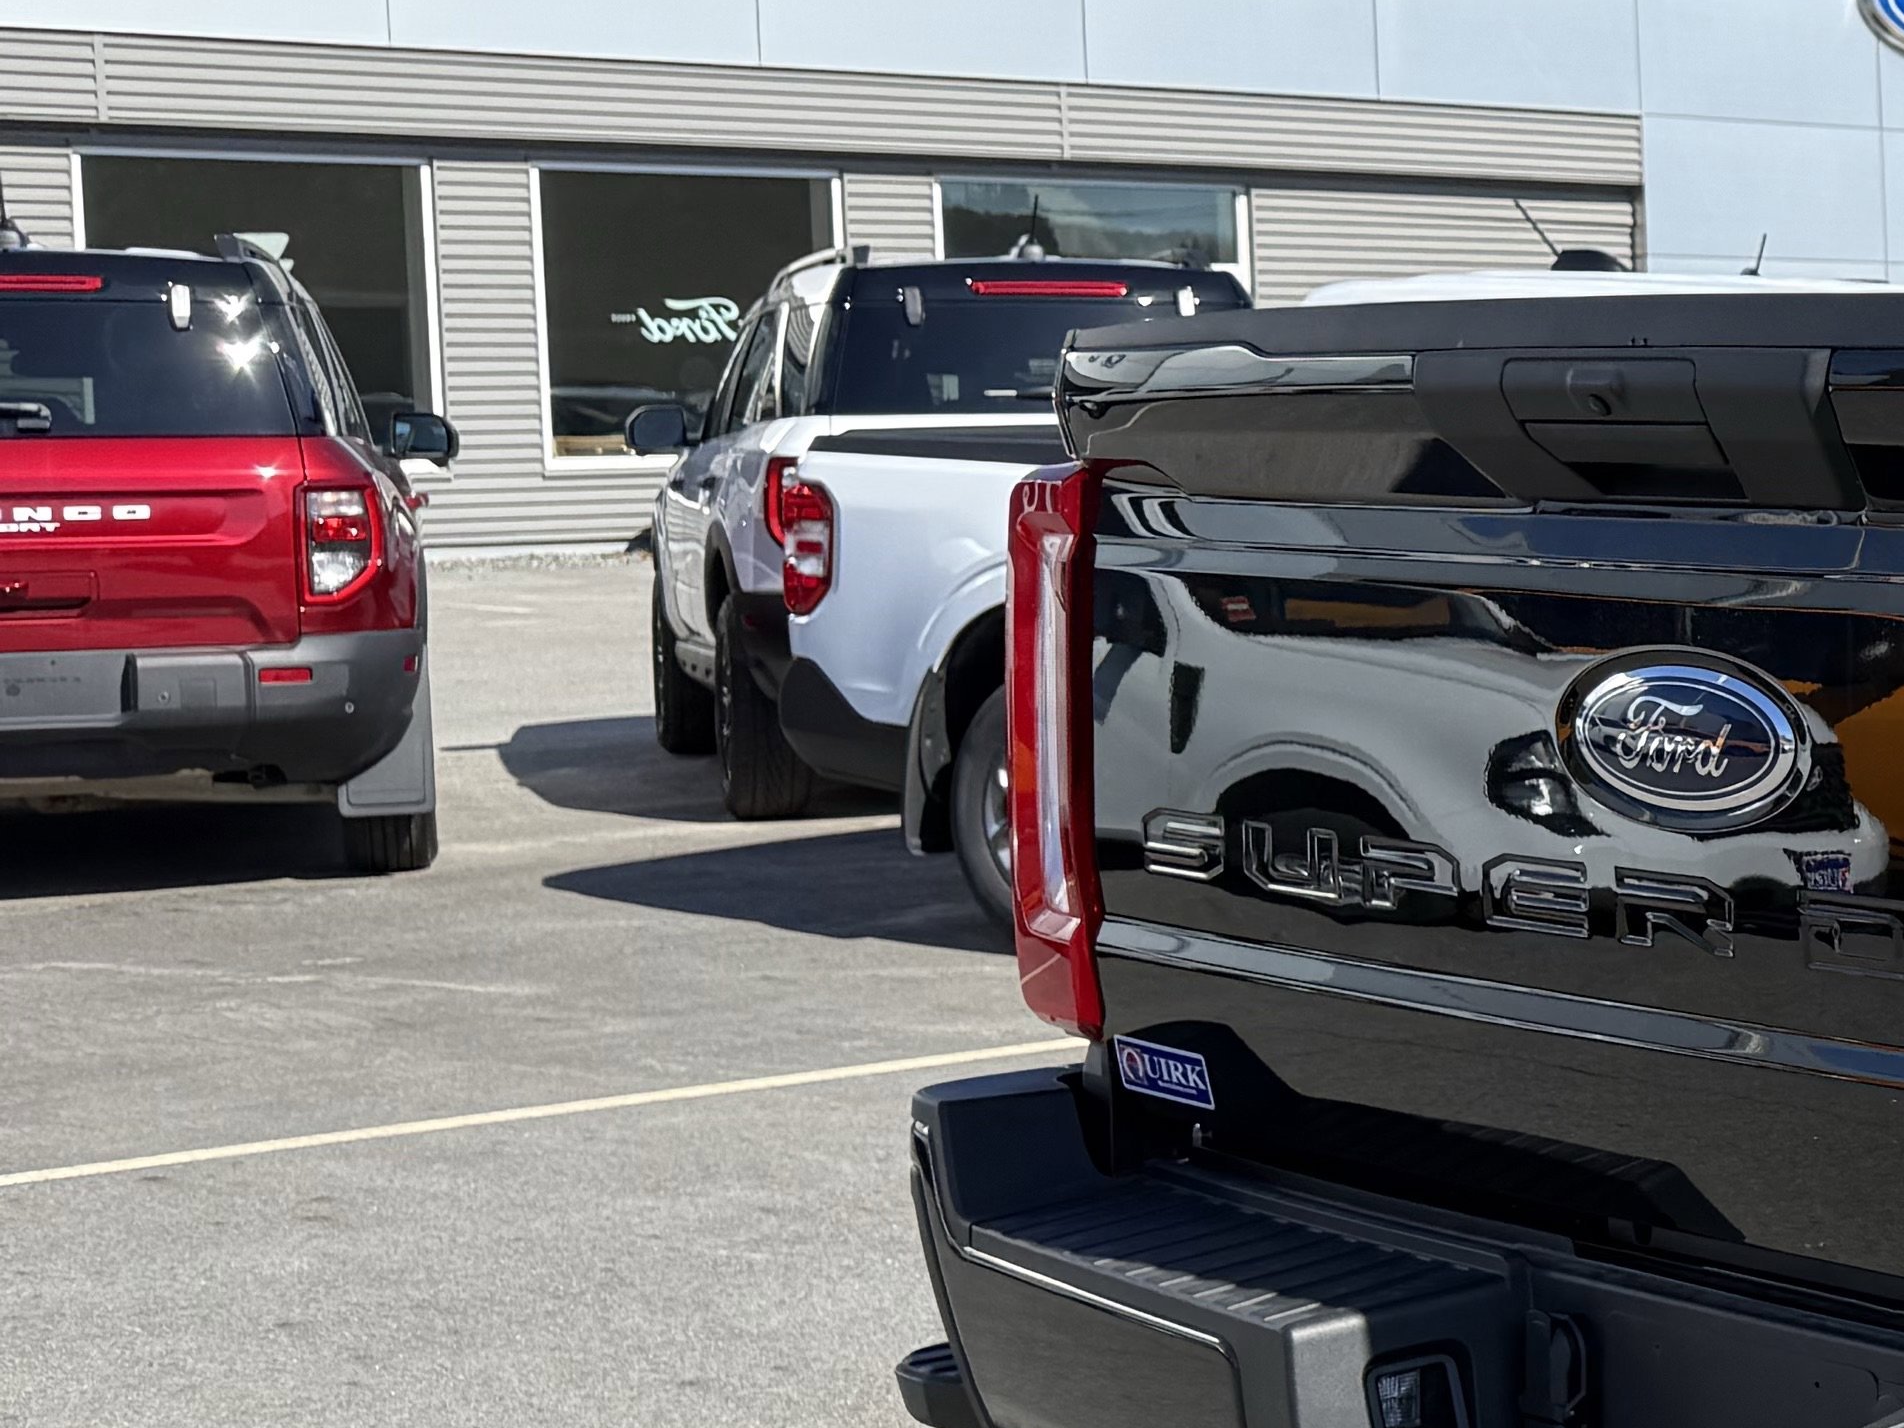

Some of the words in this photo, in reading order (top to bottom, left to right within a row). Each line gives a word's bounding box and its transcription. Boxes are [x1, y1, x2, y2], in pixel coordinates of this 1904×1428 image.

[0, 504, 151, 521] NCO
[1615, 695, 1733, 778] Ford
[1142, 807, 1734, 958] SUPER
[1119, 1044, 1207, 1091] QUIRK
